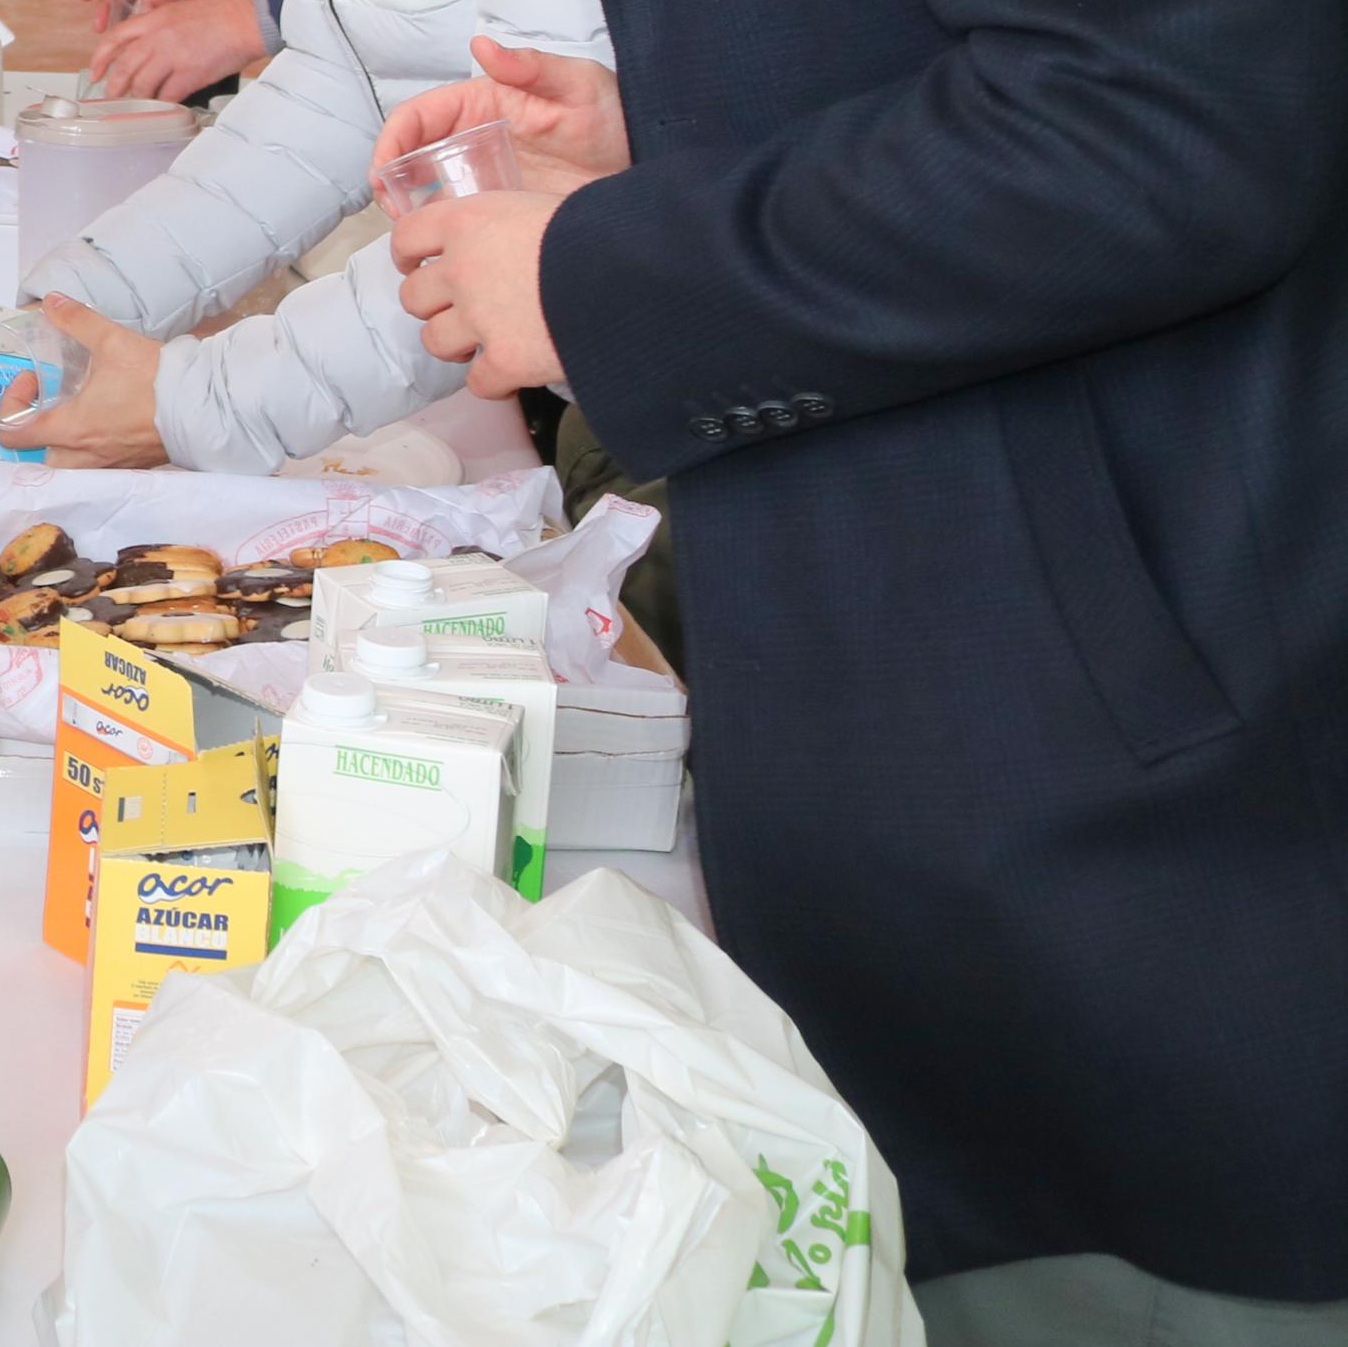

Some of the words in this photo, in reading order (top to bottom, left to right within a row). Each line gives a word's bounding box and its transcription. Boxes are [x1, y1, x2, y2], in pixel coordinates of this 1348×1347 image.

[423, 615, 506, 637] HACENDADO
[104, 650, 147, 685] AZÚCAR
[101, 683, 150, 712] acor
[95, 720, 124, 738] acor
[67, 755, 91, 788] 50
[92, 777, 105, 796] S
[336, 749, 442, 787] HACENDADO
[137, 872, 234, 904] acor
[136, 906, 229, 931] AZÚCAR
[135, 924, 228, 947] BLANCO
